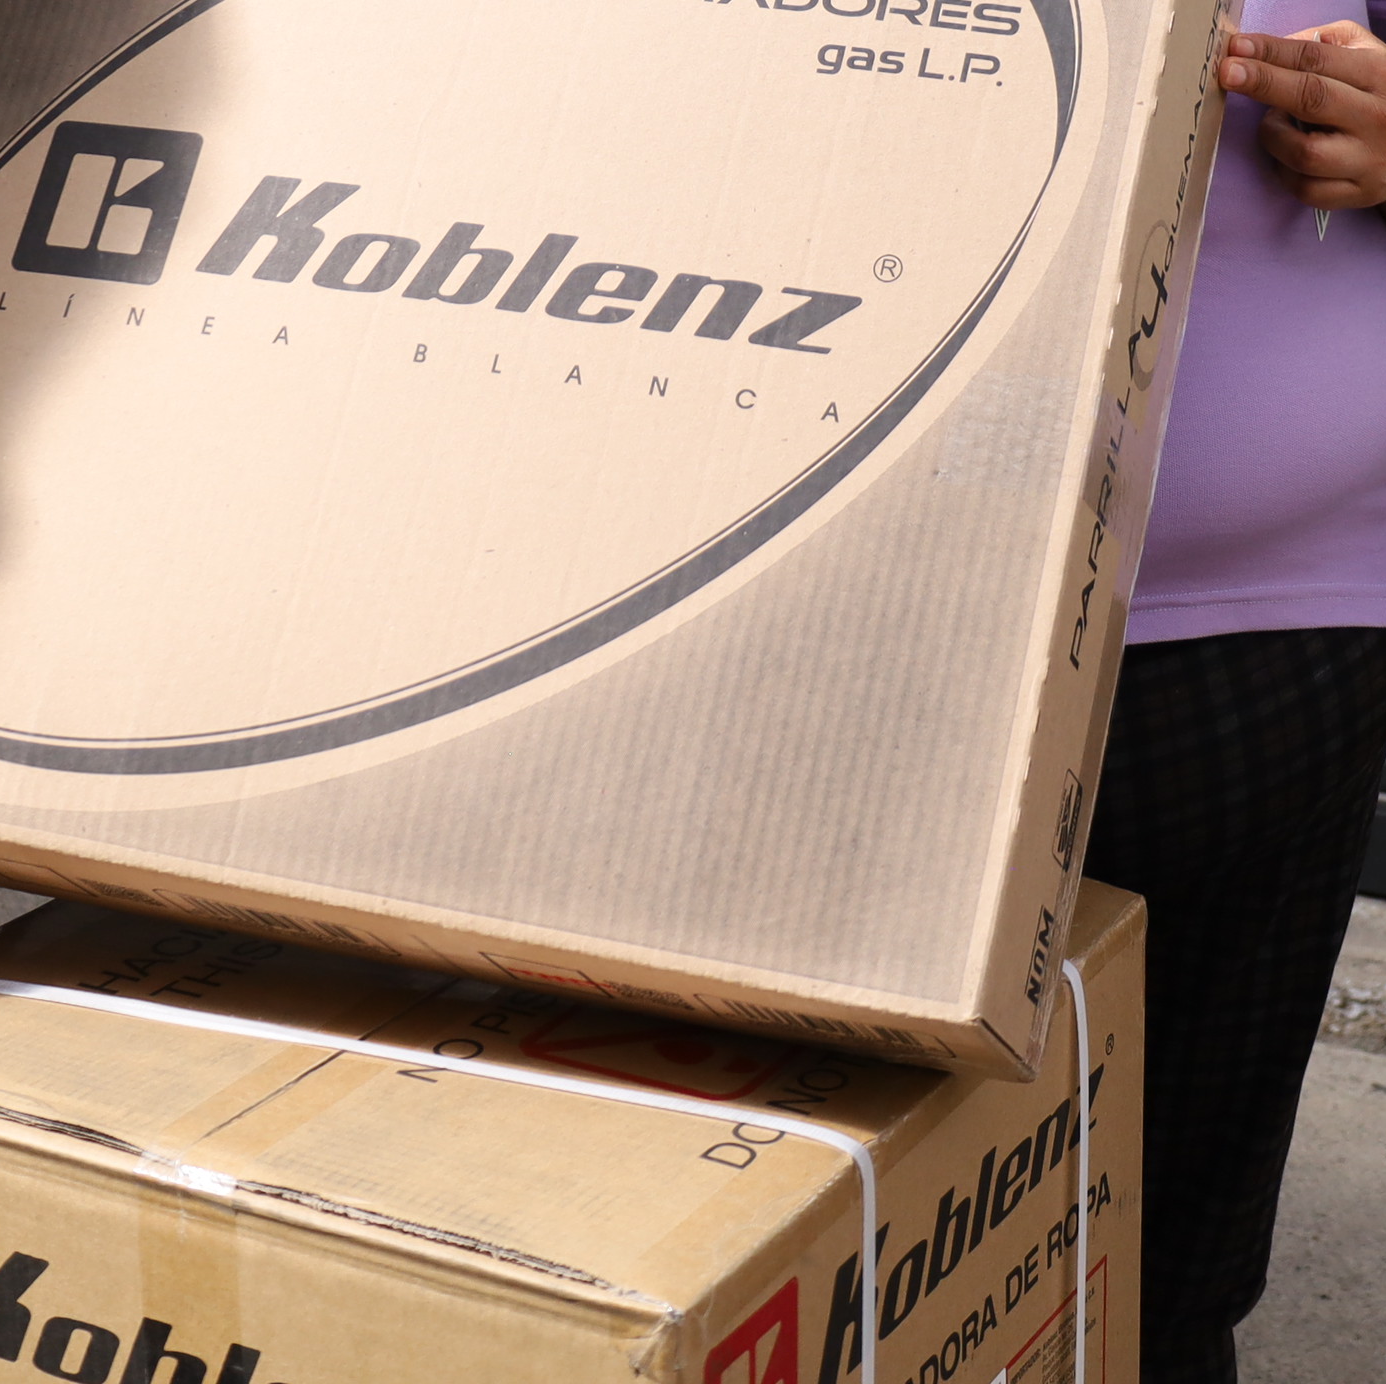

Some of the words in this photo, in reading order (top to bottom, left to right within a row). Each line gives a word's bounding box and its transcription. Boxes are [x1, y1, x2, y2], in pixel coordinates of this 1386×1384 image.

[816, 40, 906, 77] gas
[917, 46, 1006, 88] L.P.
[195, 174, 863, 356] Koblenz
[413, 342, 842, 425] BLANCA
[1068, 329, 1142, 671] PARRILLA
[1026, 906, 1055, 1007] NOM
[905, 1293, 998, 1384] DORA
[1004, 1244, 1040, 1315] DE
